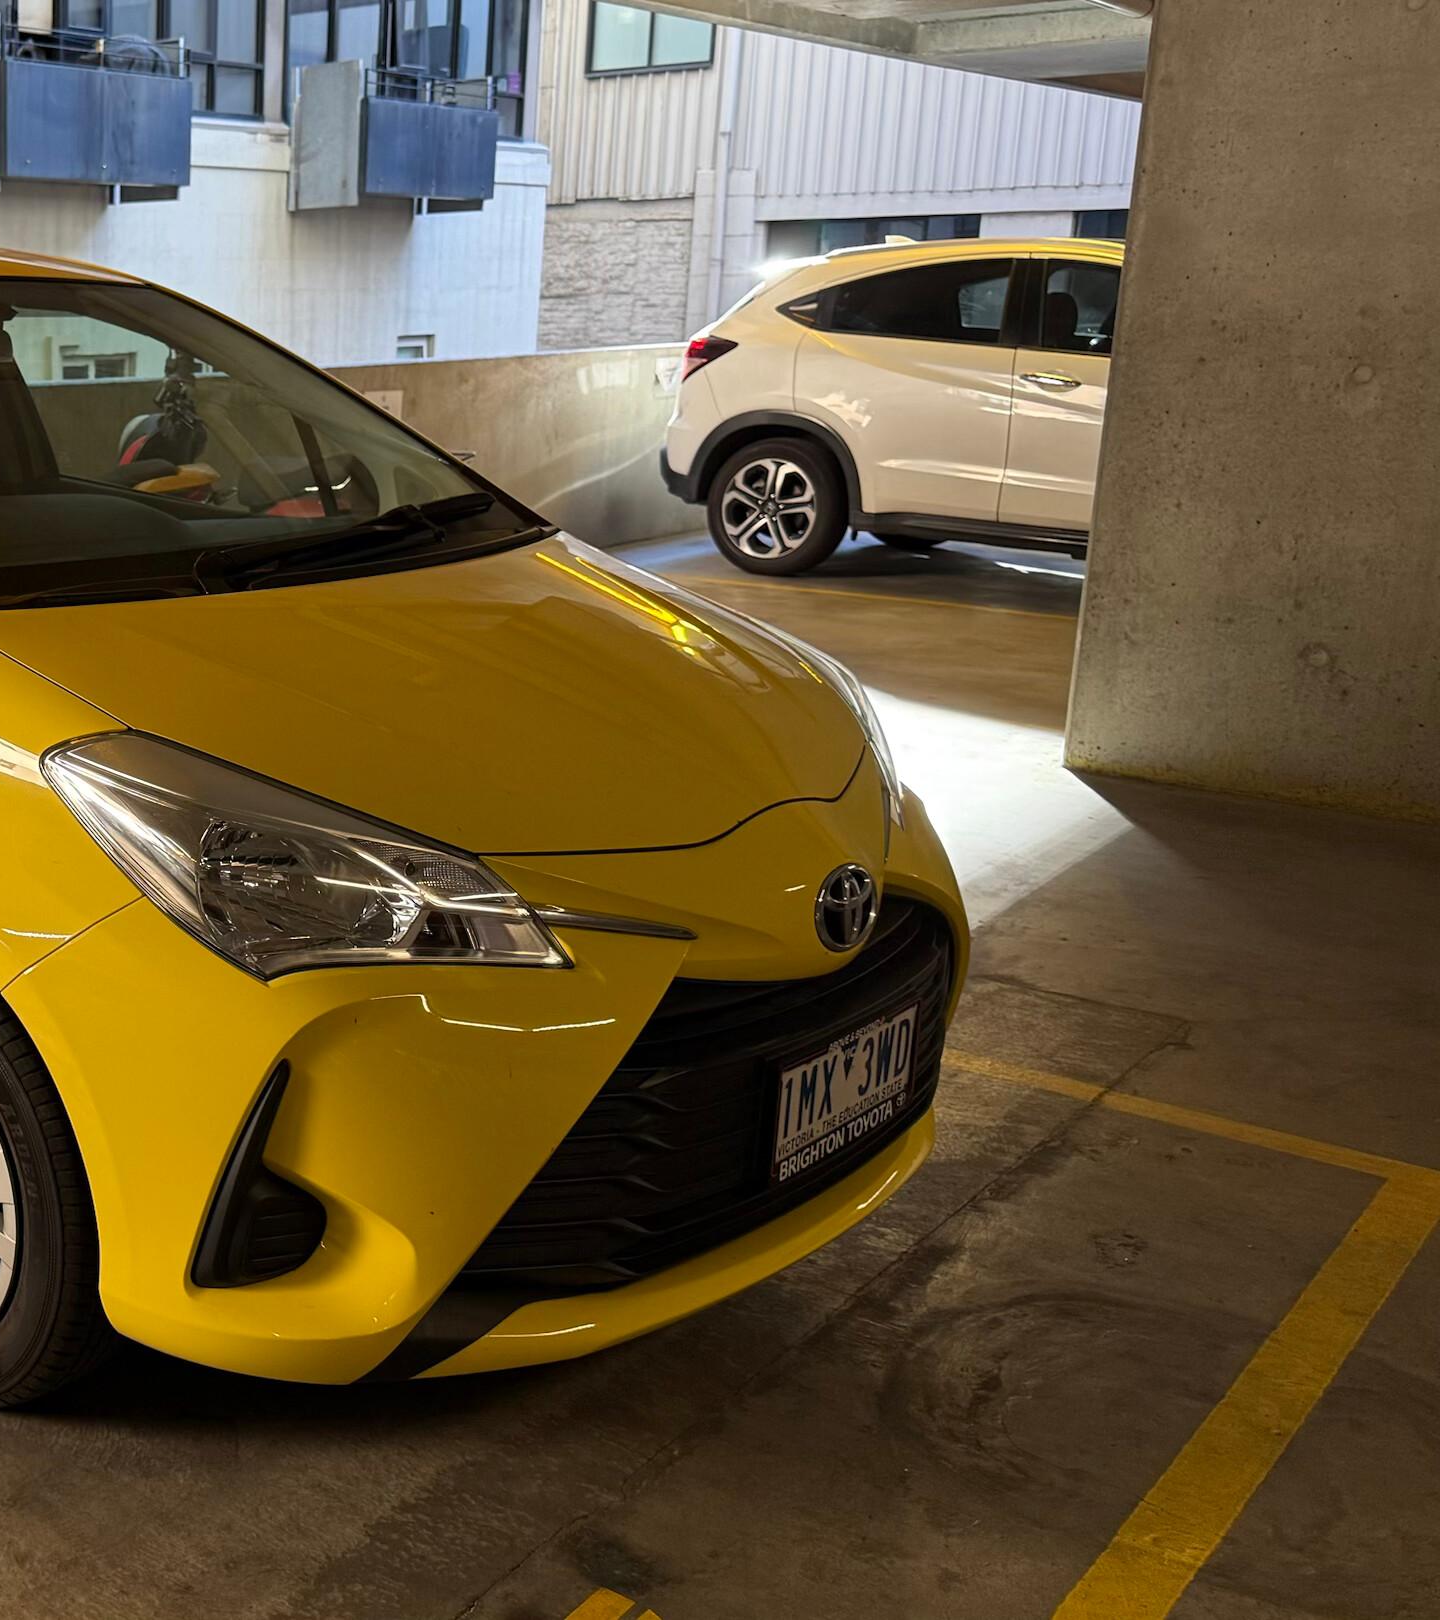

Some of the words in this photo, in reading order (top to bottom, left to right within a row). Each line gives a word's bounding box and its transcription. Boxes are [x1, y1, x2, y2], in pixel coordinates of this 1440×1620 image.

[777, 1128, 814, 1158] VICTORIA
[822, 1114, 837, 1133] THE
[838, 1091, 880, 1123] EDUCATION
[881, 1079, 903, 1099] STATE
[783, 1055, 838, 1139] 1MX
[858, 1018, 910, 1096] 3WD
[779, 1129, 845, 1182] BRIGHTON
[848, 1100, 893, 1142] TOYOTA
